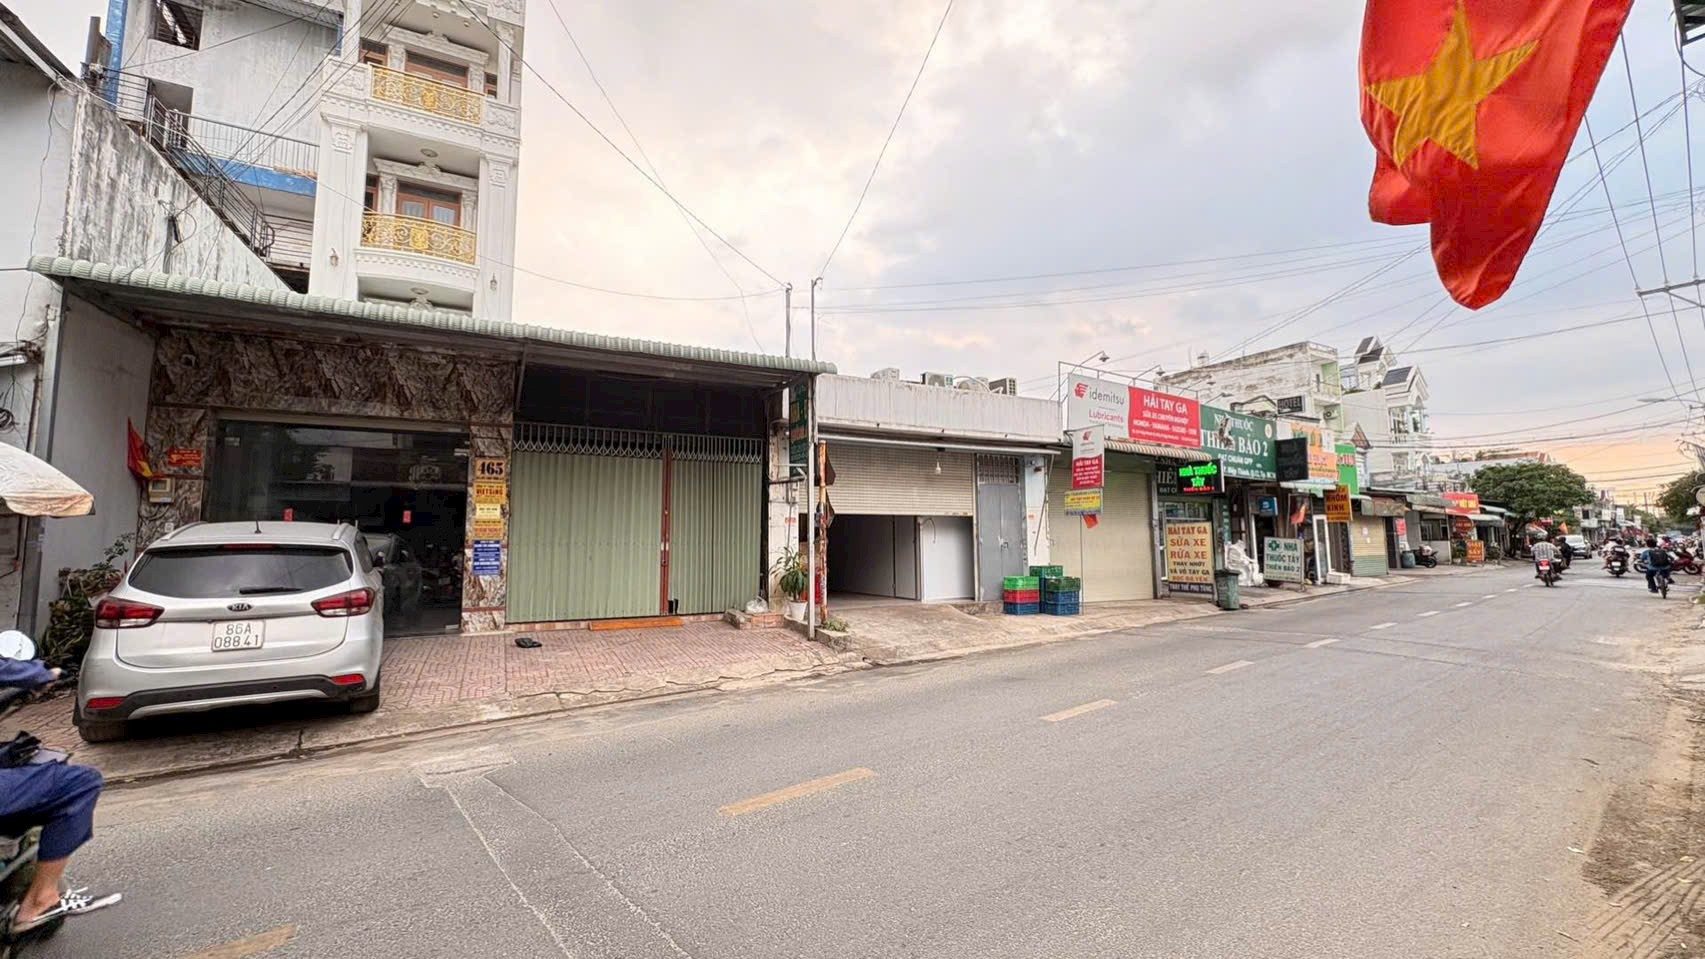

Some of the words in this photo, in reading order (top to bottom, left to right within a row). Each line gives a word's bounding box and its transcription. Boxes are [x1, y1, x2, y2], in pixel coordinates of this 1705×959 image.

[1088, 387, 1125, 406] idemitsu
[1160, 398, 1175, 411] TAY
[1175, 402, 1188, 415] GA
[1088, 409, 1124, 423] Lubricants
[1238, 433, 1261, 456] BẢO
[1262, 440, 1268, 457] 2
[480, 462, 504, 476] 465
[1197, 526, 1208, 534] GA
[1170, 535, 1190, 547] SỬA
[1193, 539, 1207, 547] XE
[1170, 547, 1191, 559] RỬA
[1194, 551, 1207, 560] XE
[225, 623, 252, 635] 86A
